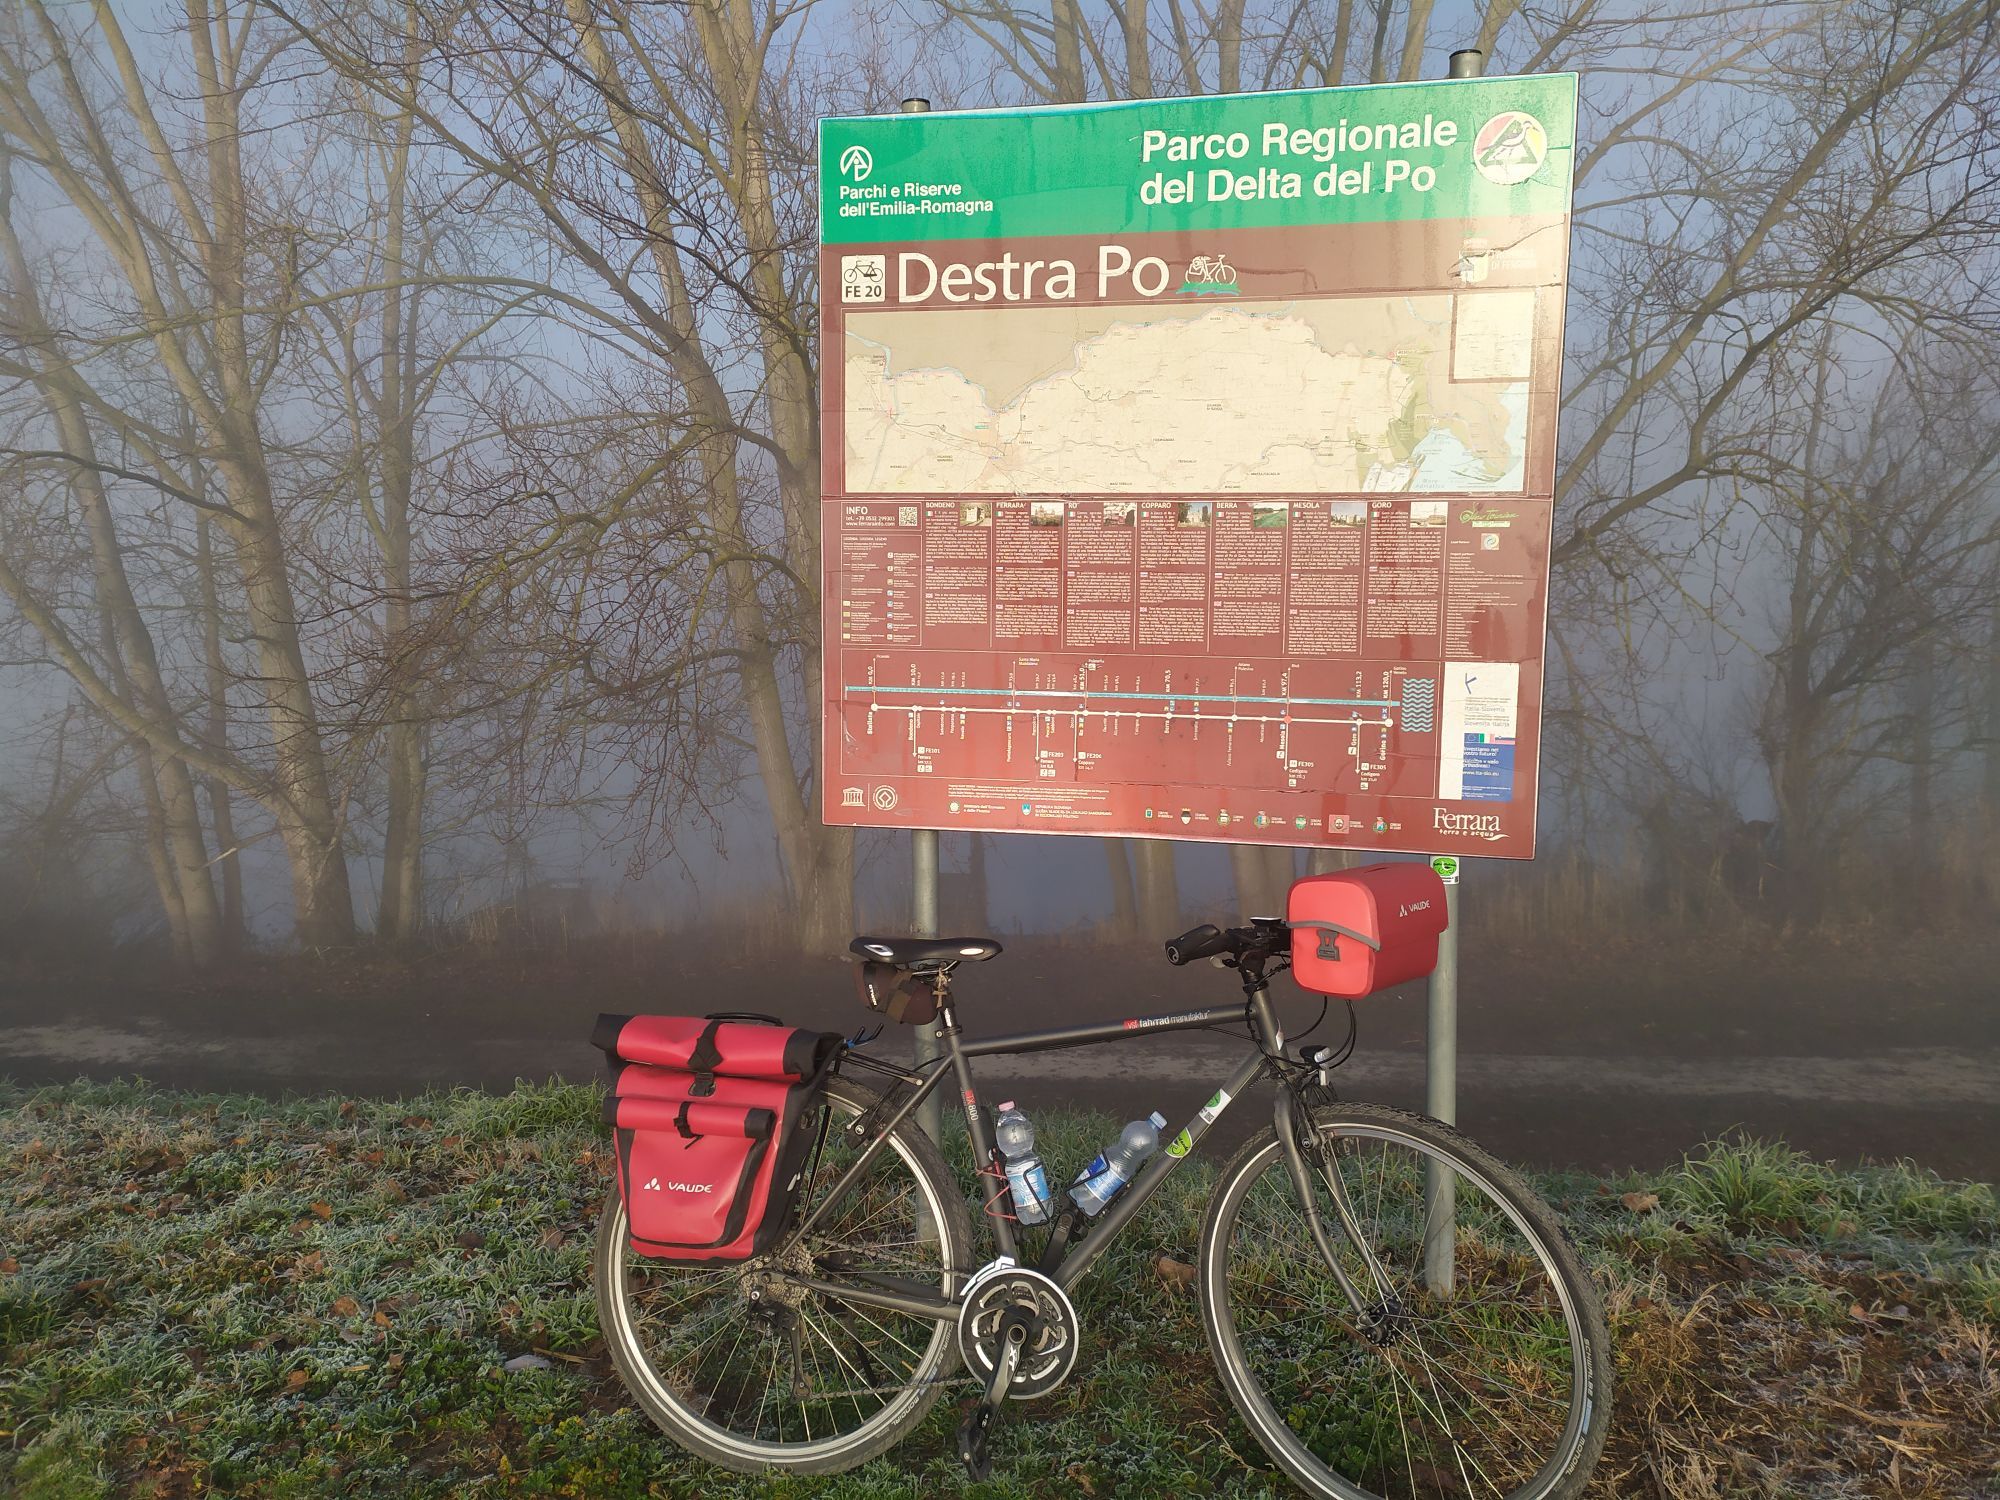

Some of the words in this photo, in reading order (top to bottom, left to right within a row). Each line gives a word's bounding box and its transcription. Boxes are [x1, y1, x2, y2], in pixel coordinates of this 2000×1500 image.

[1143, 130, 1249, 163] Parco
[1262, 113, 1458, 162] Regionale
[839, 184, 886, 200] Parchi
[890, 187, 900, 198] e
[904, 182, 962, 197] Riserve
[1140, 170, 1194, 205] del
[1207, 166, 1301, 203] Delta
[1313, 161, 1370, 196] del
[1384, 160, 1436, 194] Po
[839, 200, 993, 217] dell'Emilia-Romagna
[898, 252, 1076, 304] Destra
[1098, 245, 1170, 298] Po
[845, 286, 862, 298] FE
[864, 285, 882, 298] 20
[846, 506, 868, 515] INFO
[1432, 807, 1501, 832] Ferrara
[1470, 830, 1494, 838] acqua
[1408, 900, 1431, 912] VAUDE
[667, 1181, 713, 1194] VAUDE
[1584, 1338, 1594, 1397] SCHWALBE
